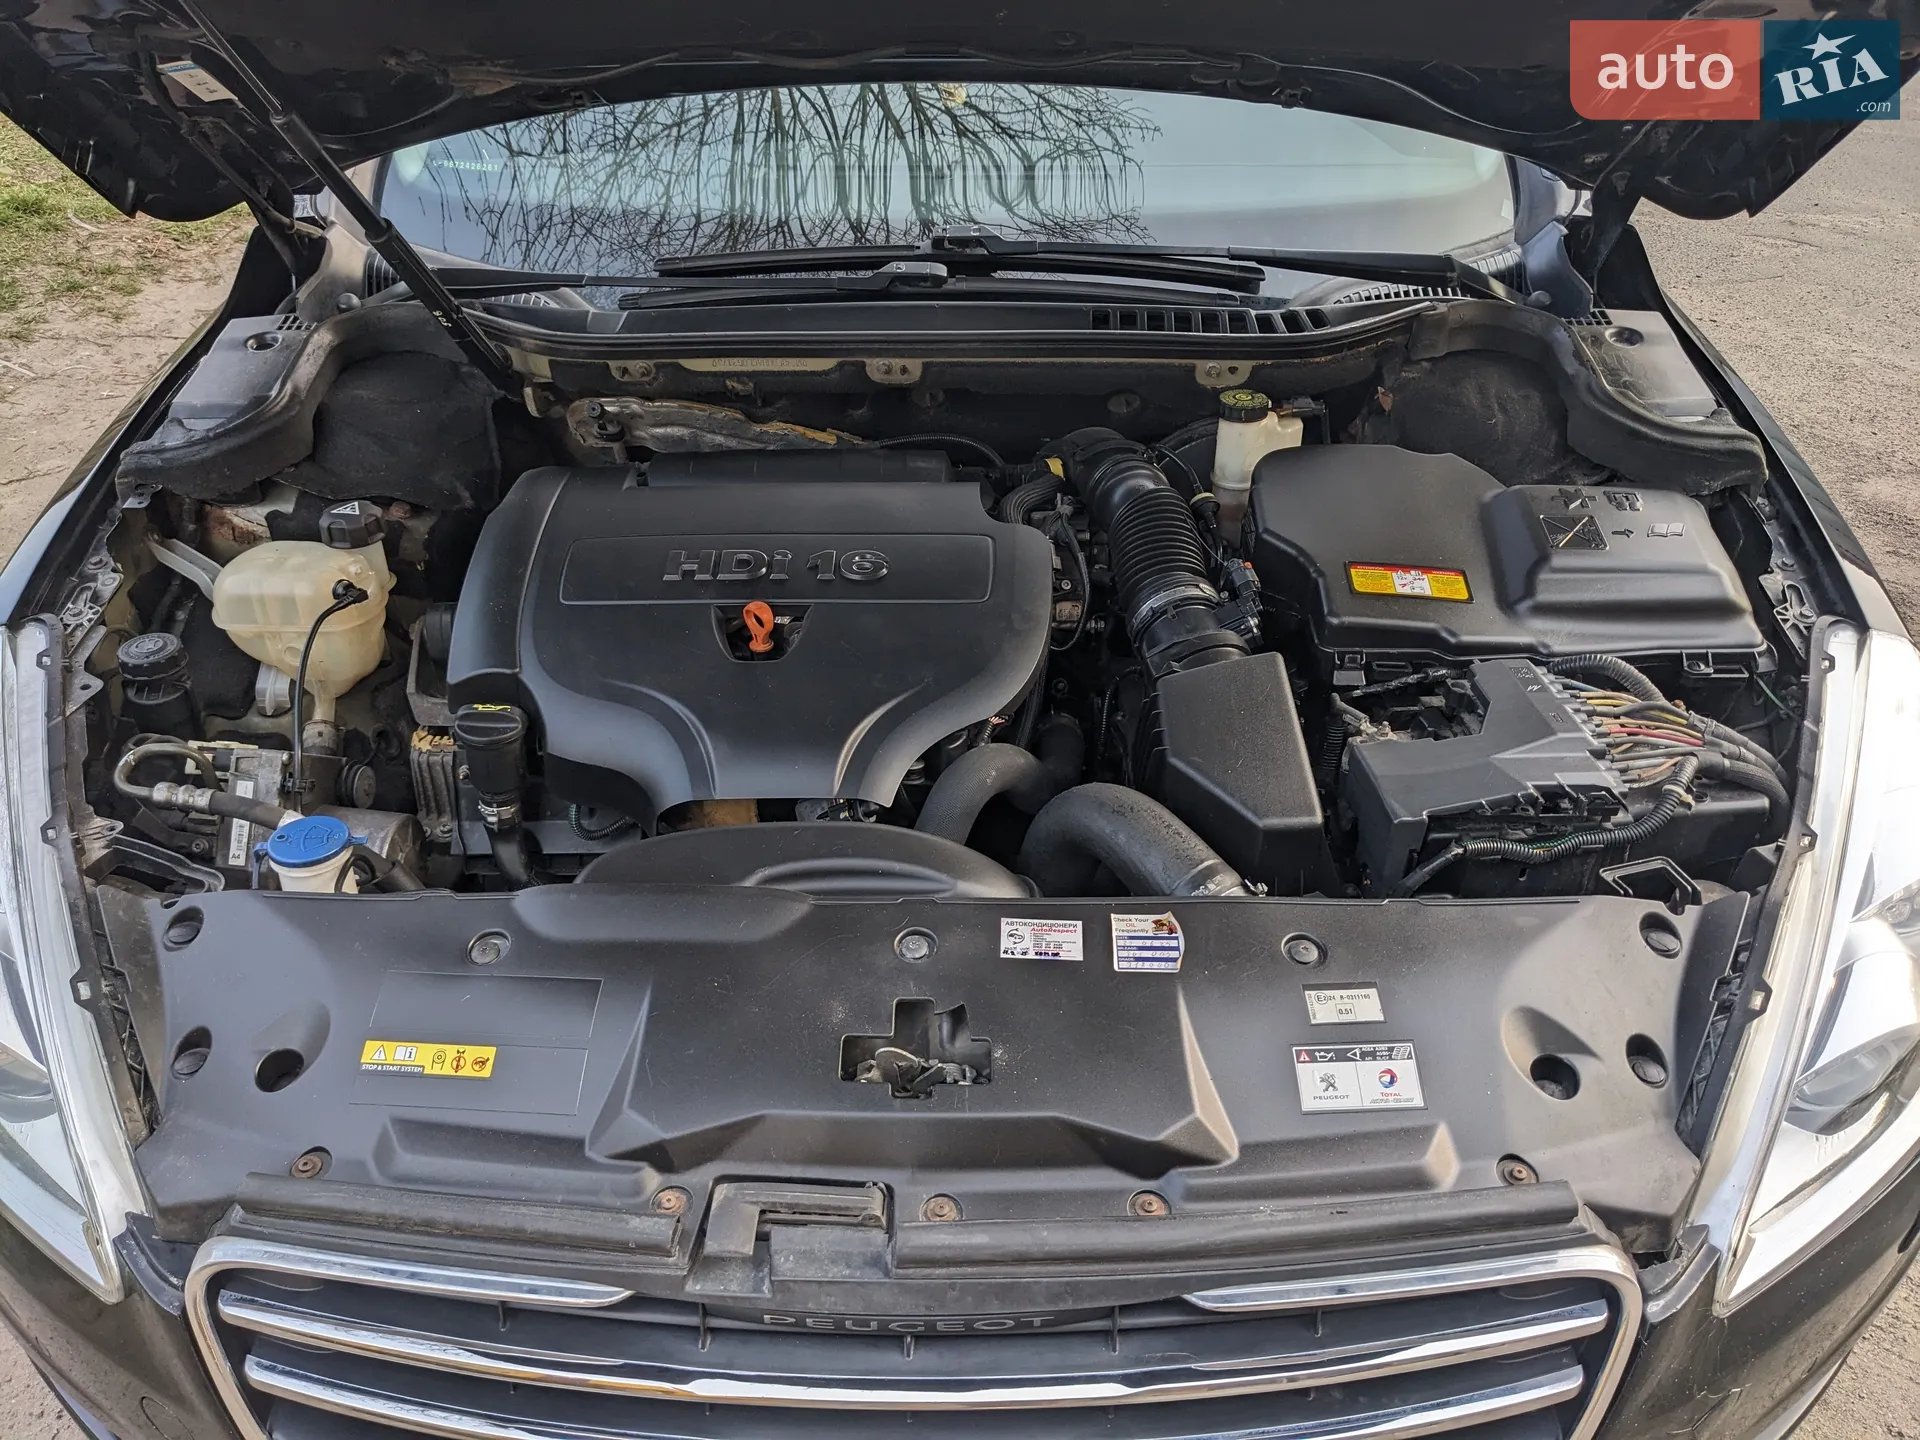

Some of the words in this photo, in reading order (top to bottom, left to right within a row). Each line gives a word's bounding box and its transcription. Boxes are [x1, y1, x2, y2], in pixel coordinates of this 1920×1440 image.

[662, 550, 793, 580] HDi
[806, 550, 891, 580] 16
[1005, 920, 1078, 928] АВТОКОНДИЦІОНЕРИ
[763, 1314, 1055, 1332] PEUGEOT
